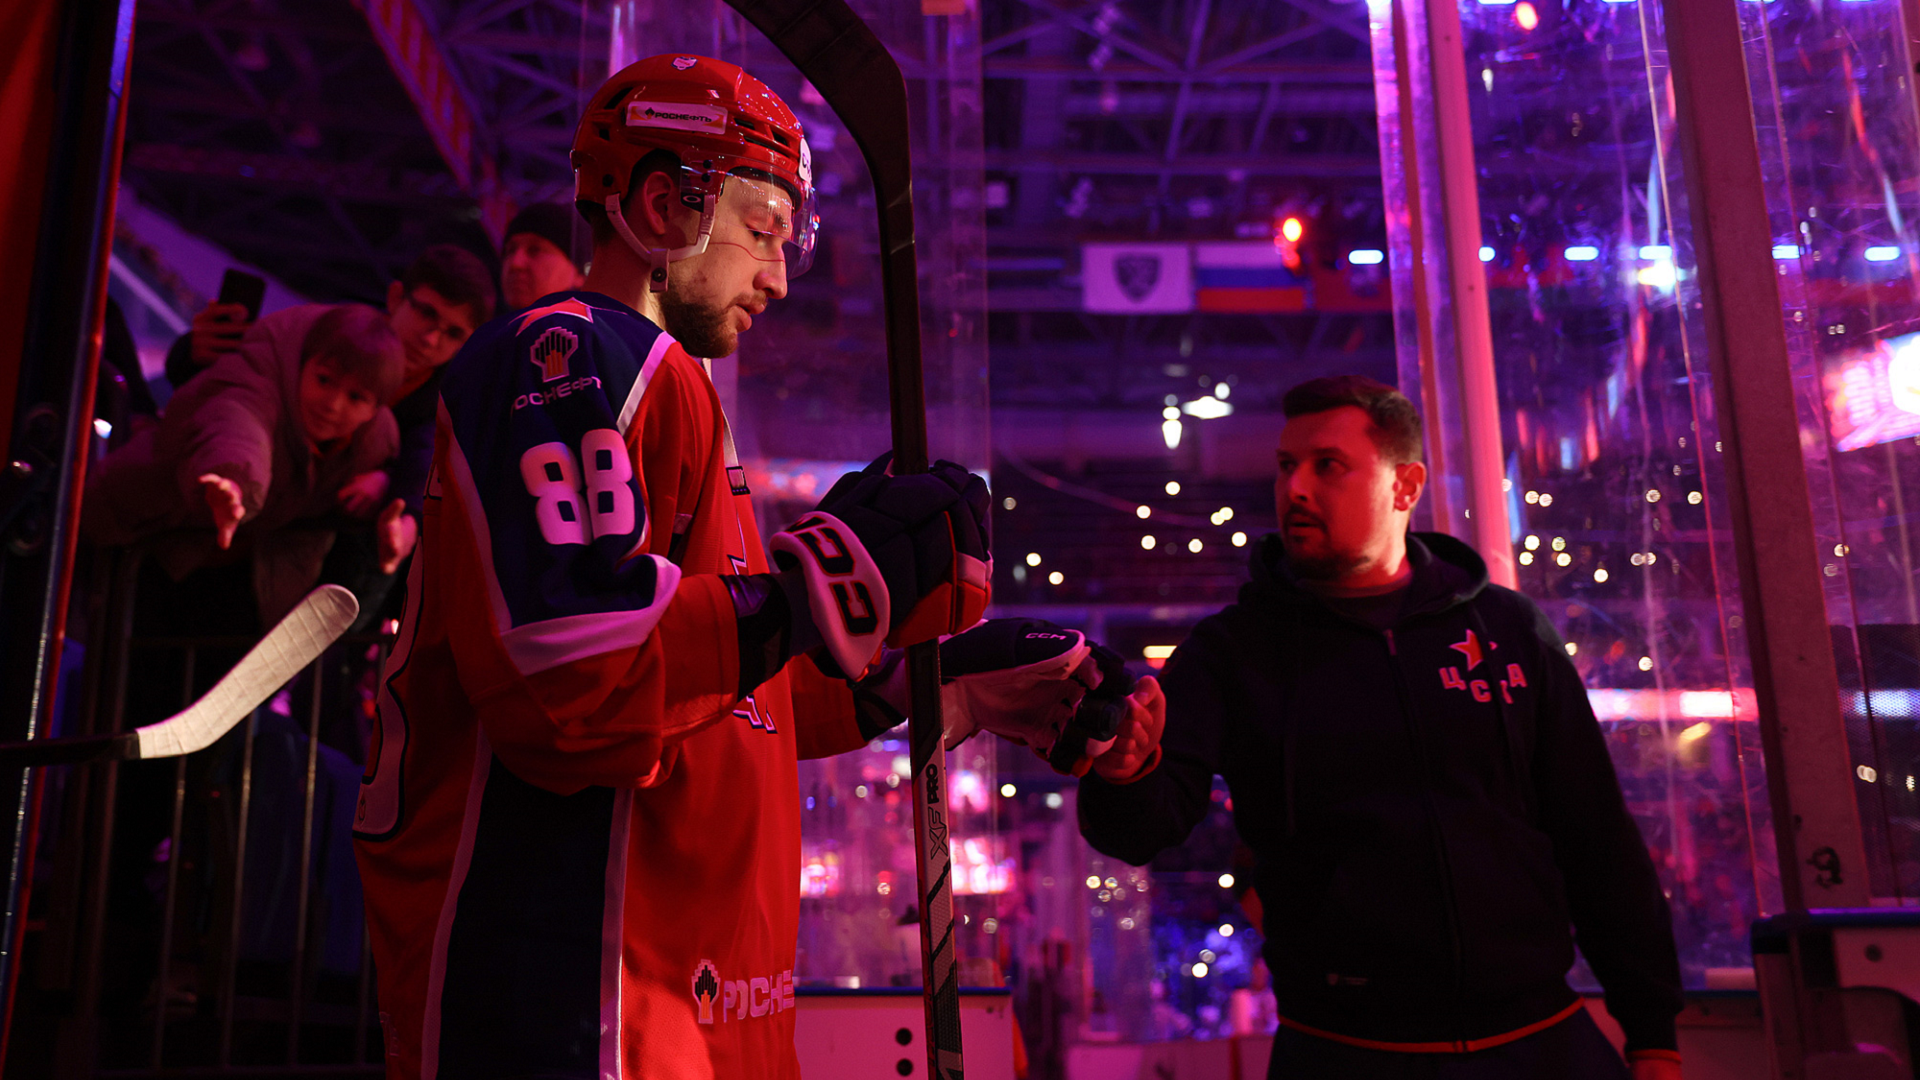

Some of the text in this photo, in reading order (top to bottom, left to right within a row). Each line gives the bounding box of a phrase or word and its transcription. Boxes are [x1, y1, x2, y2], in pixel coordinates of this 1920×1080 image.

[654, 112, 712, 122] РОСНЕФТЬ
[519, 428, 636, 546] 88
[1025, 632, 1067, 641] CCM
[925, 763, 940, 804] PRO
